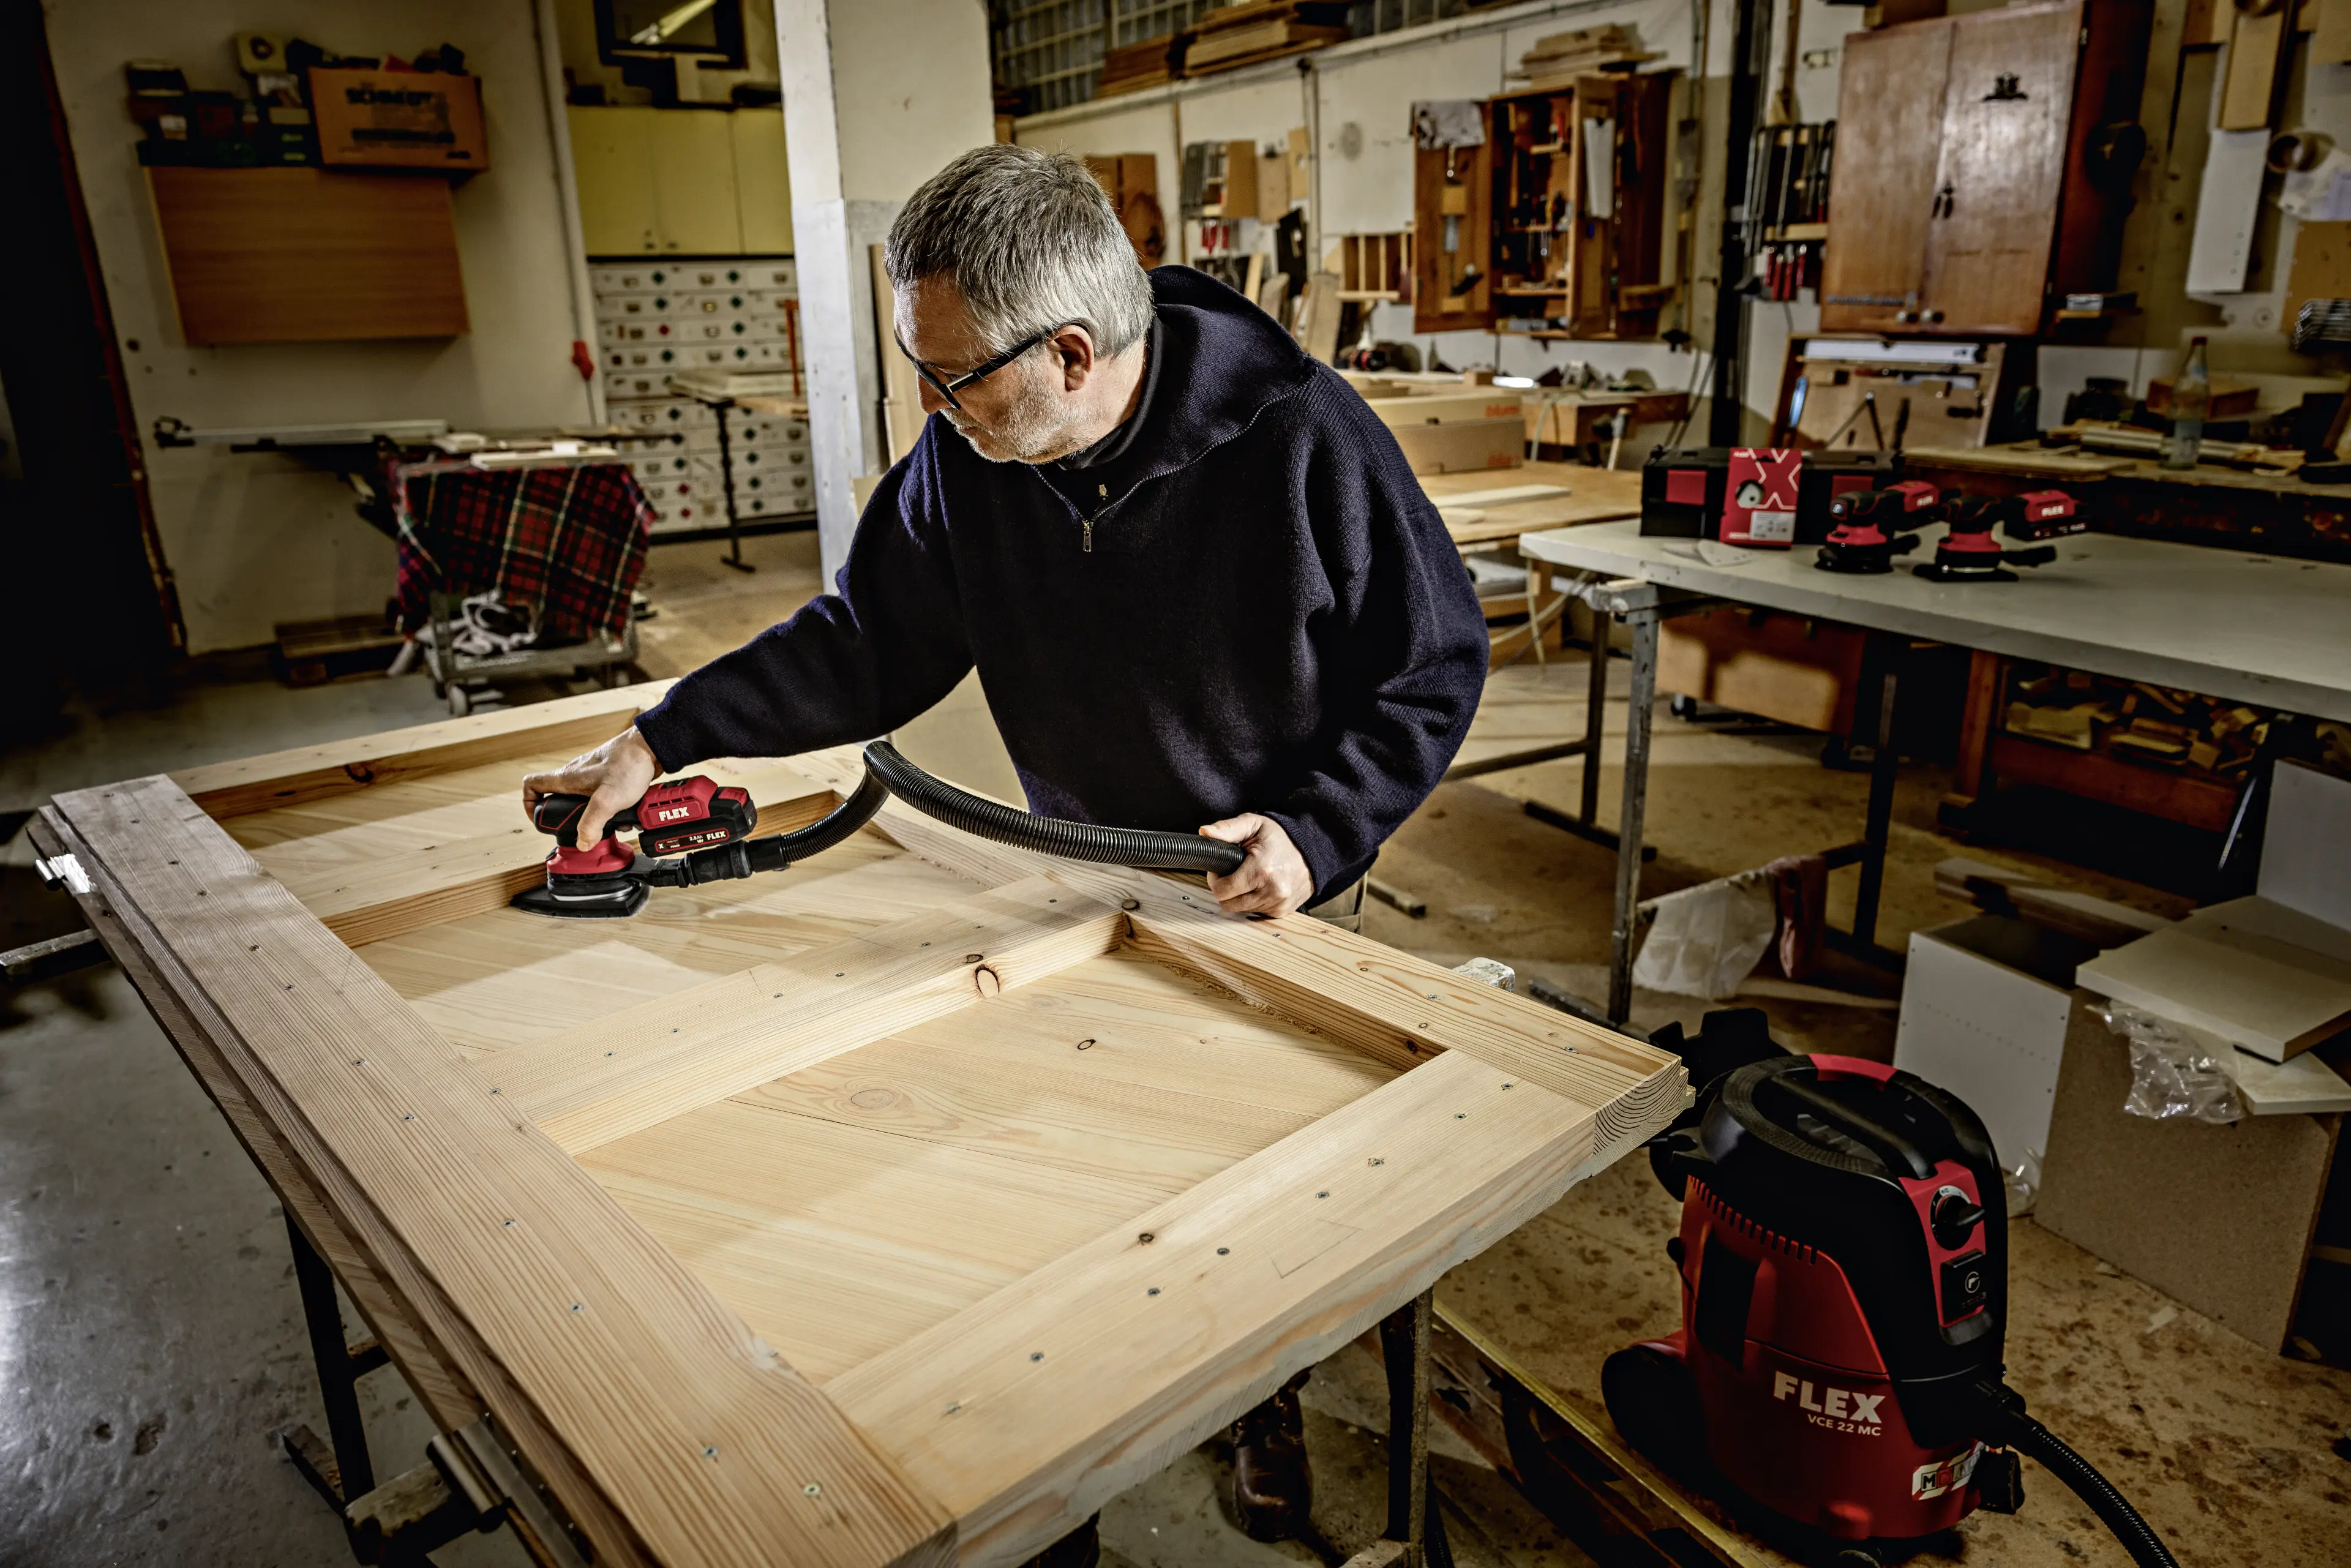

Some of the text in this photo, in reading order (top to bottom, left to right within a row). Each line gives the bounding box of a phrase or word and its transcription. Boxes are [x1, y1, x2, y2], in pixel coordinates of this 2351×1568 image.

[659, 807, 689, 821] FLEX
[707, 831, 726, 840] FLEX
[1774, 1370, 1886, 1424] FLEX
[1807, 1413, 1881, 1436] VCE 22 MC
